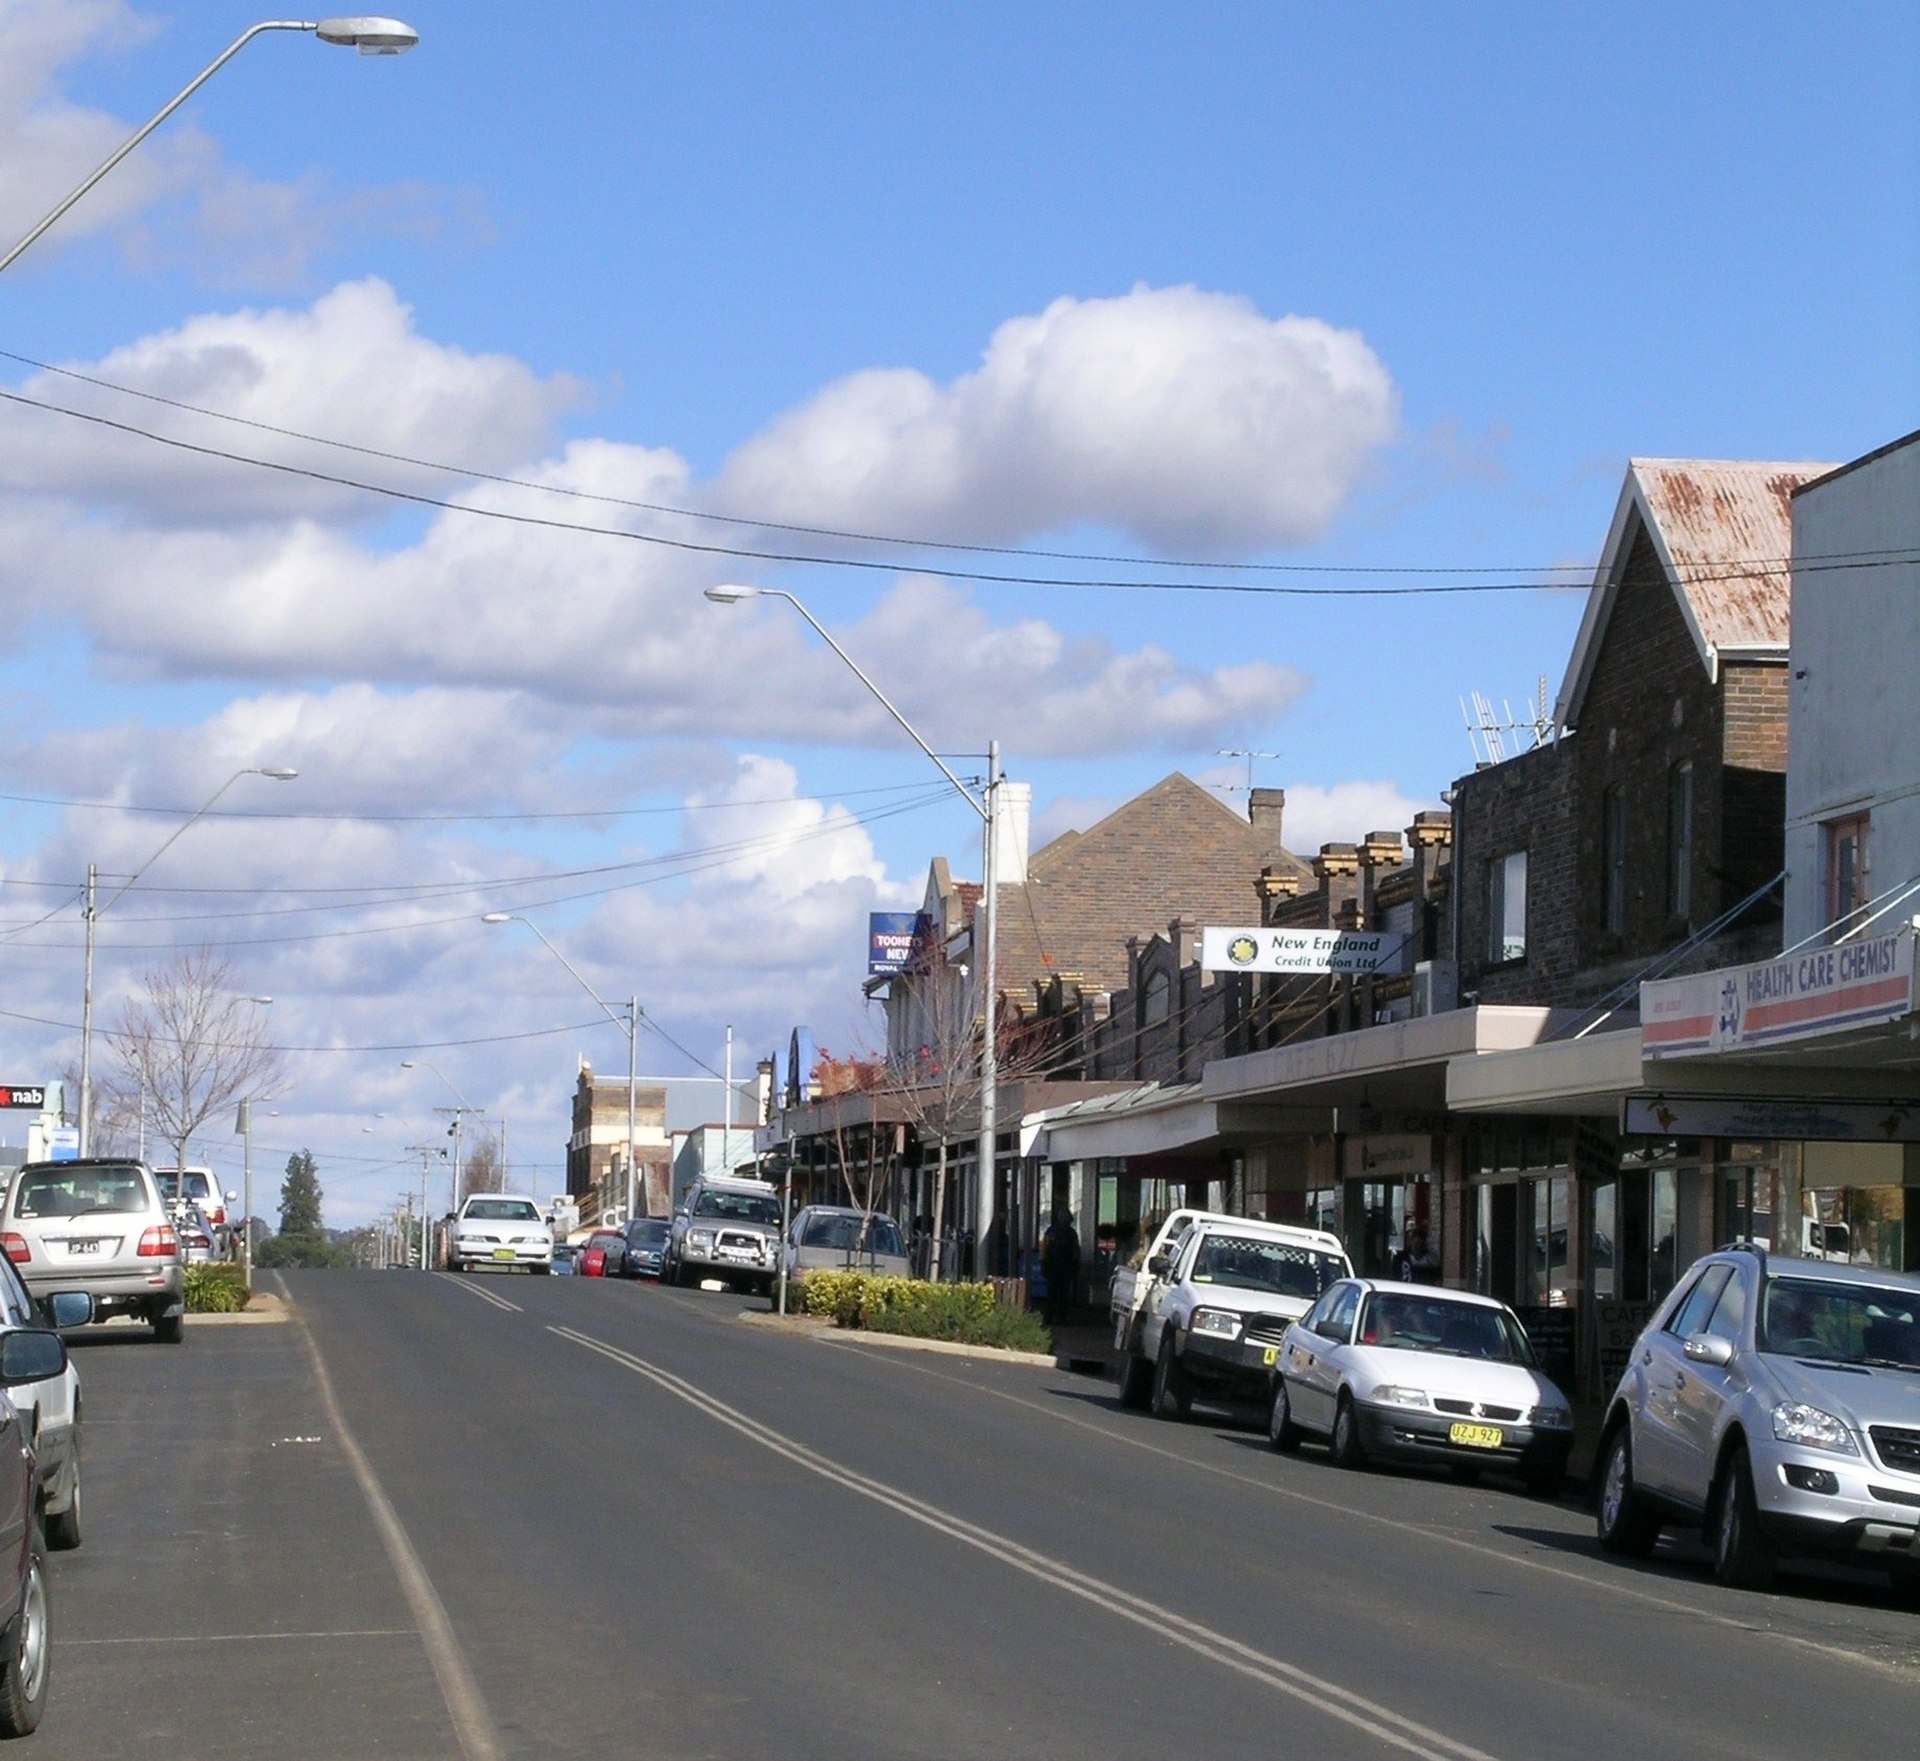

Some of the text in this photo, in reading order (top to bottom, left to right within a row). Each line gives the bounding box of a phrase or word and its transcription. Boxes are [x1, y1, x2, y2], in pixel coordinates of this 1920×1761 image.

[1272, 936, 1380, 955] New England
[1275, 956, 1377, 969] Credit Union Ltd
[1747, 938, 1898, 1001] HEALTH CARE CHEMIST
[12, 1089, 43, 1104] nab
